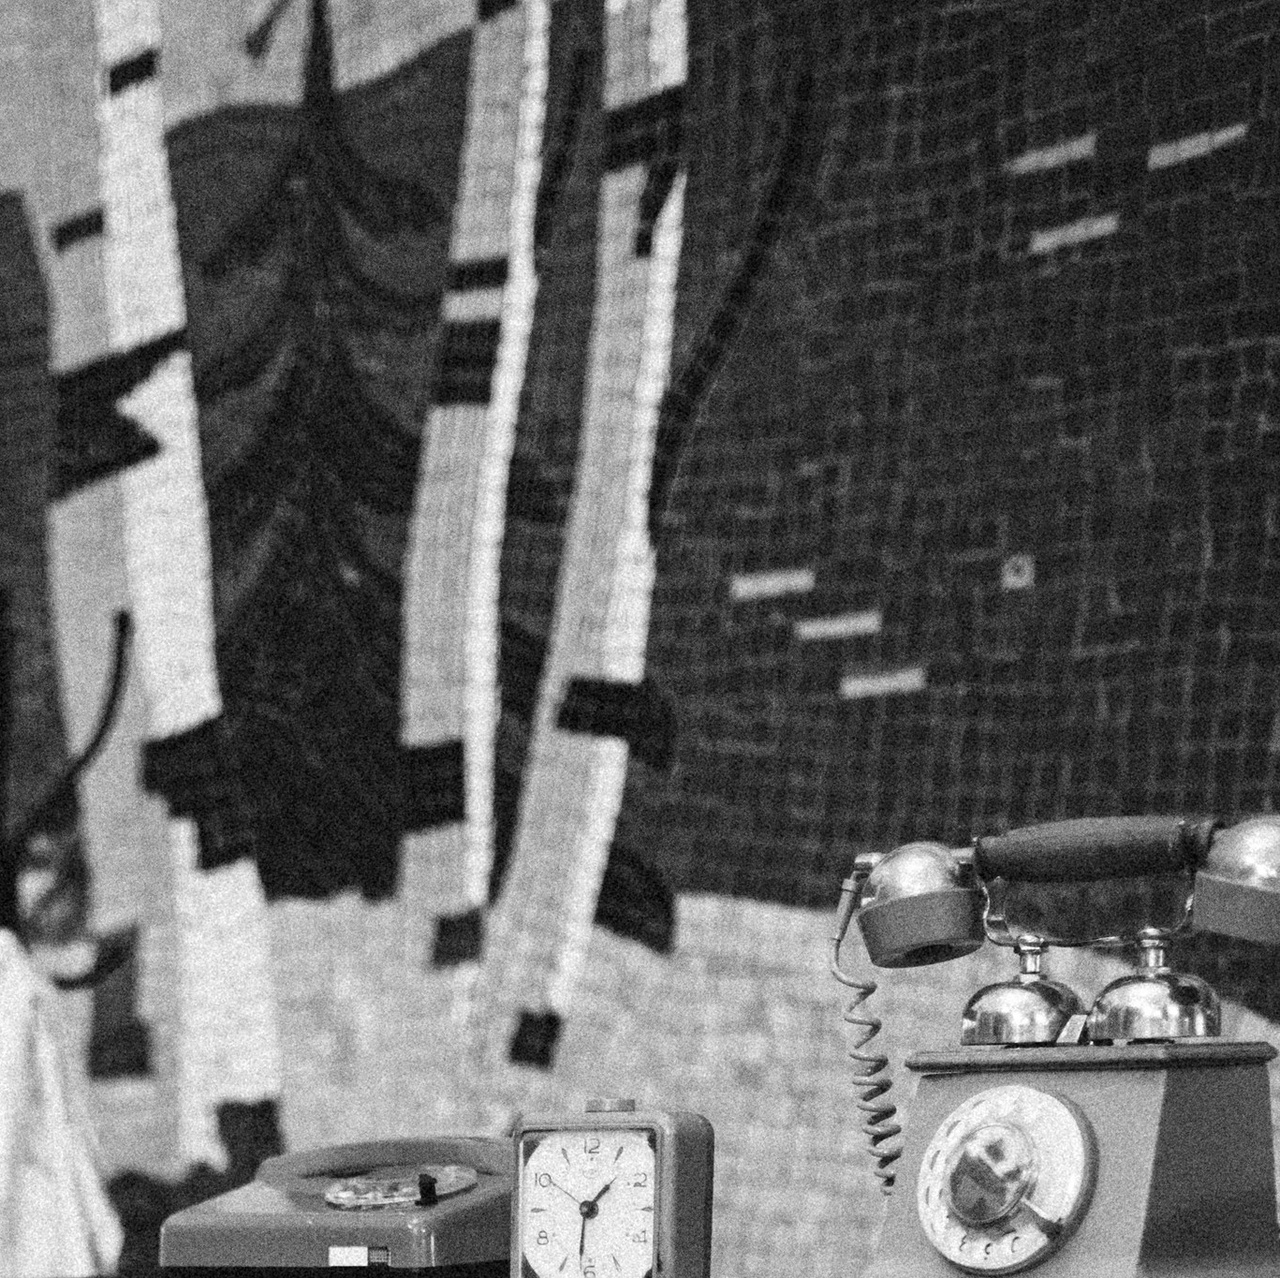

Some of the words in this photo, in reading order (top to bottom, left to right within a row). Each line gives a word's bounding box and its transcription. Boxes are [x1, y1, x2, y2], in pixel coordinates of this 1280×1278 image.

[584, 1138, 600, 1154] 12
[535, 1173, 552, 1188] 10
[633, 1172, 647, 1187] 2
[536, 1230, 549, 1245] 8
